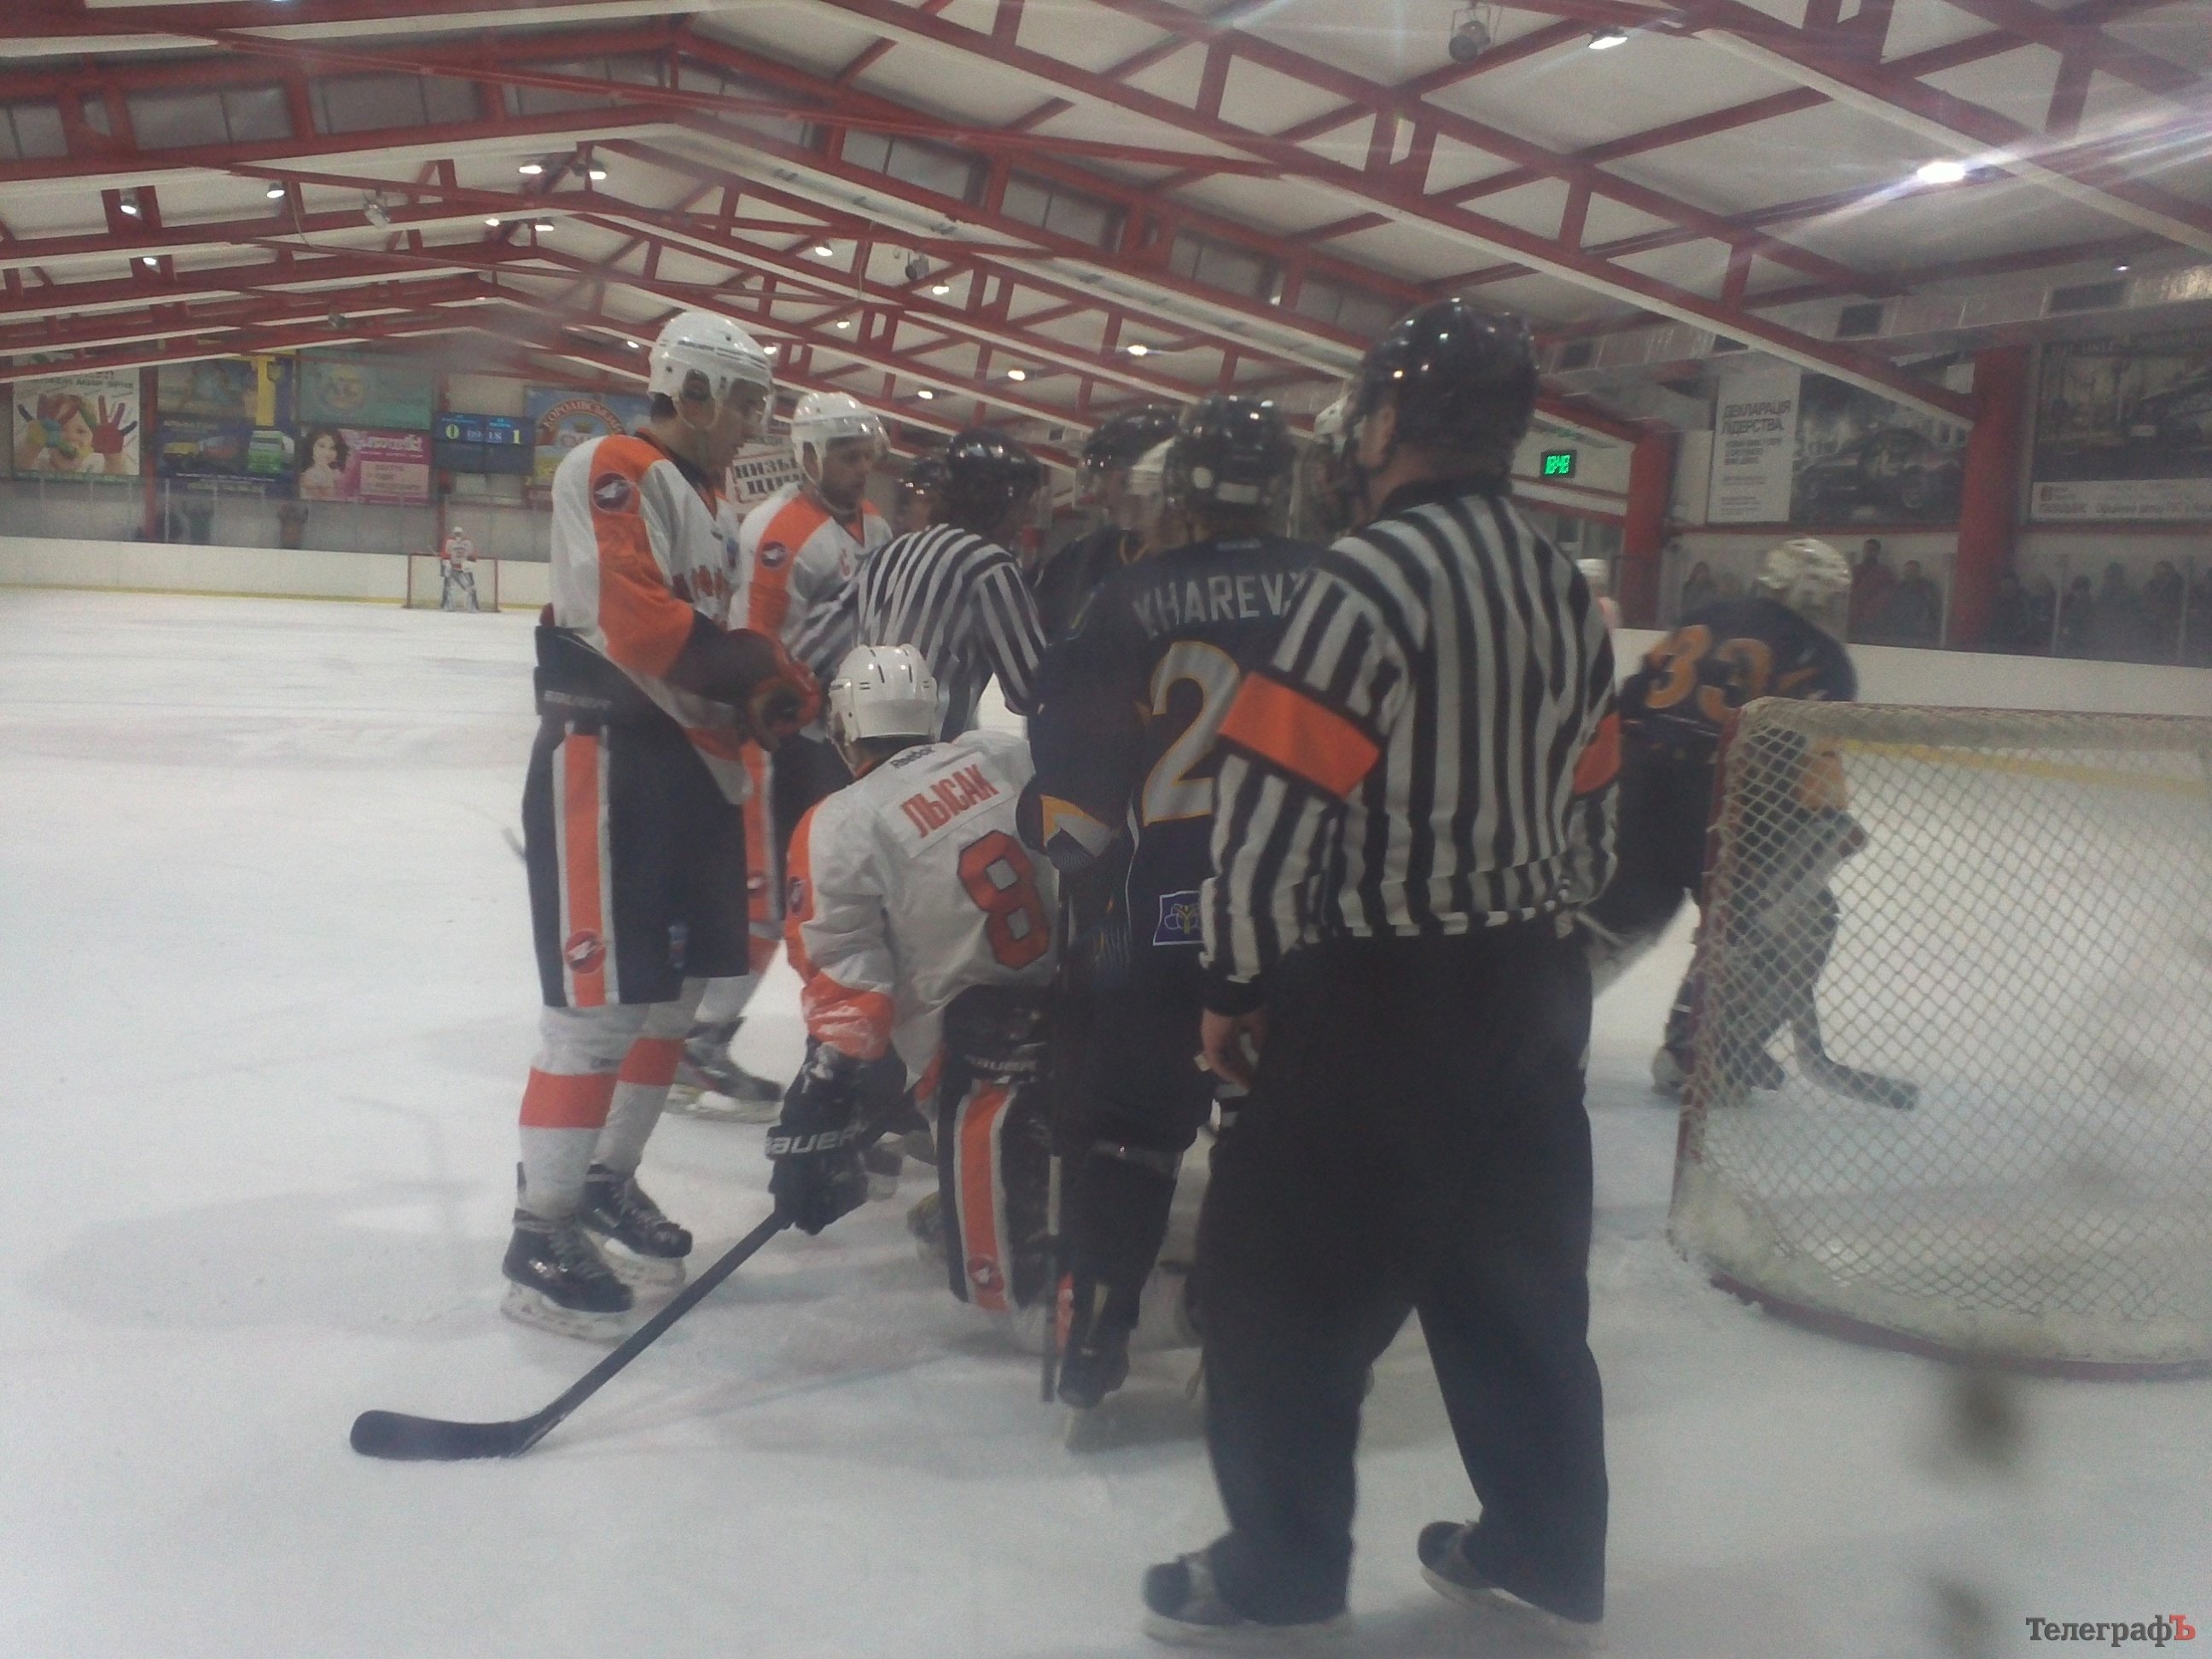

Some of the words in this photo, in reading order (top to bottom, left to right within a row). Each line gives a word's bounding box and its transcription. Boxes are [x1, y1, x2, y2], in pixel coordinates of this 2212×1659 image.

[1721, 417, 1784, 434] ЛІДЕРСТВА
[1722, 400, 1791, 419] ДЕКЛАРАЦІЯ
[1132, 571, 1299, 640] KHAREV
[1143, 640, 1241, 827] 2
[899, 764, 1000, 839] ЛЫСАК
[957, 830, 1051, 970] 8
